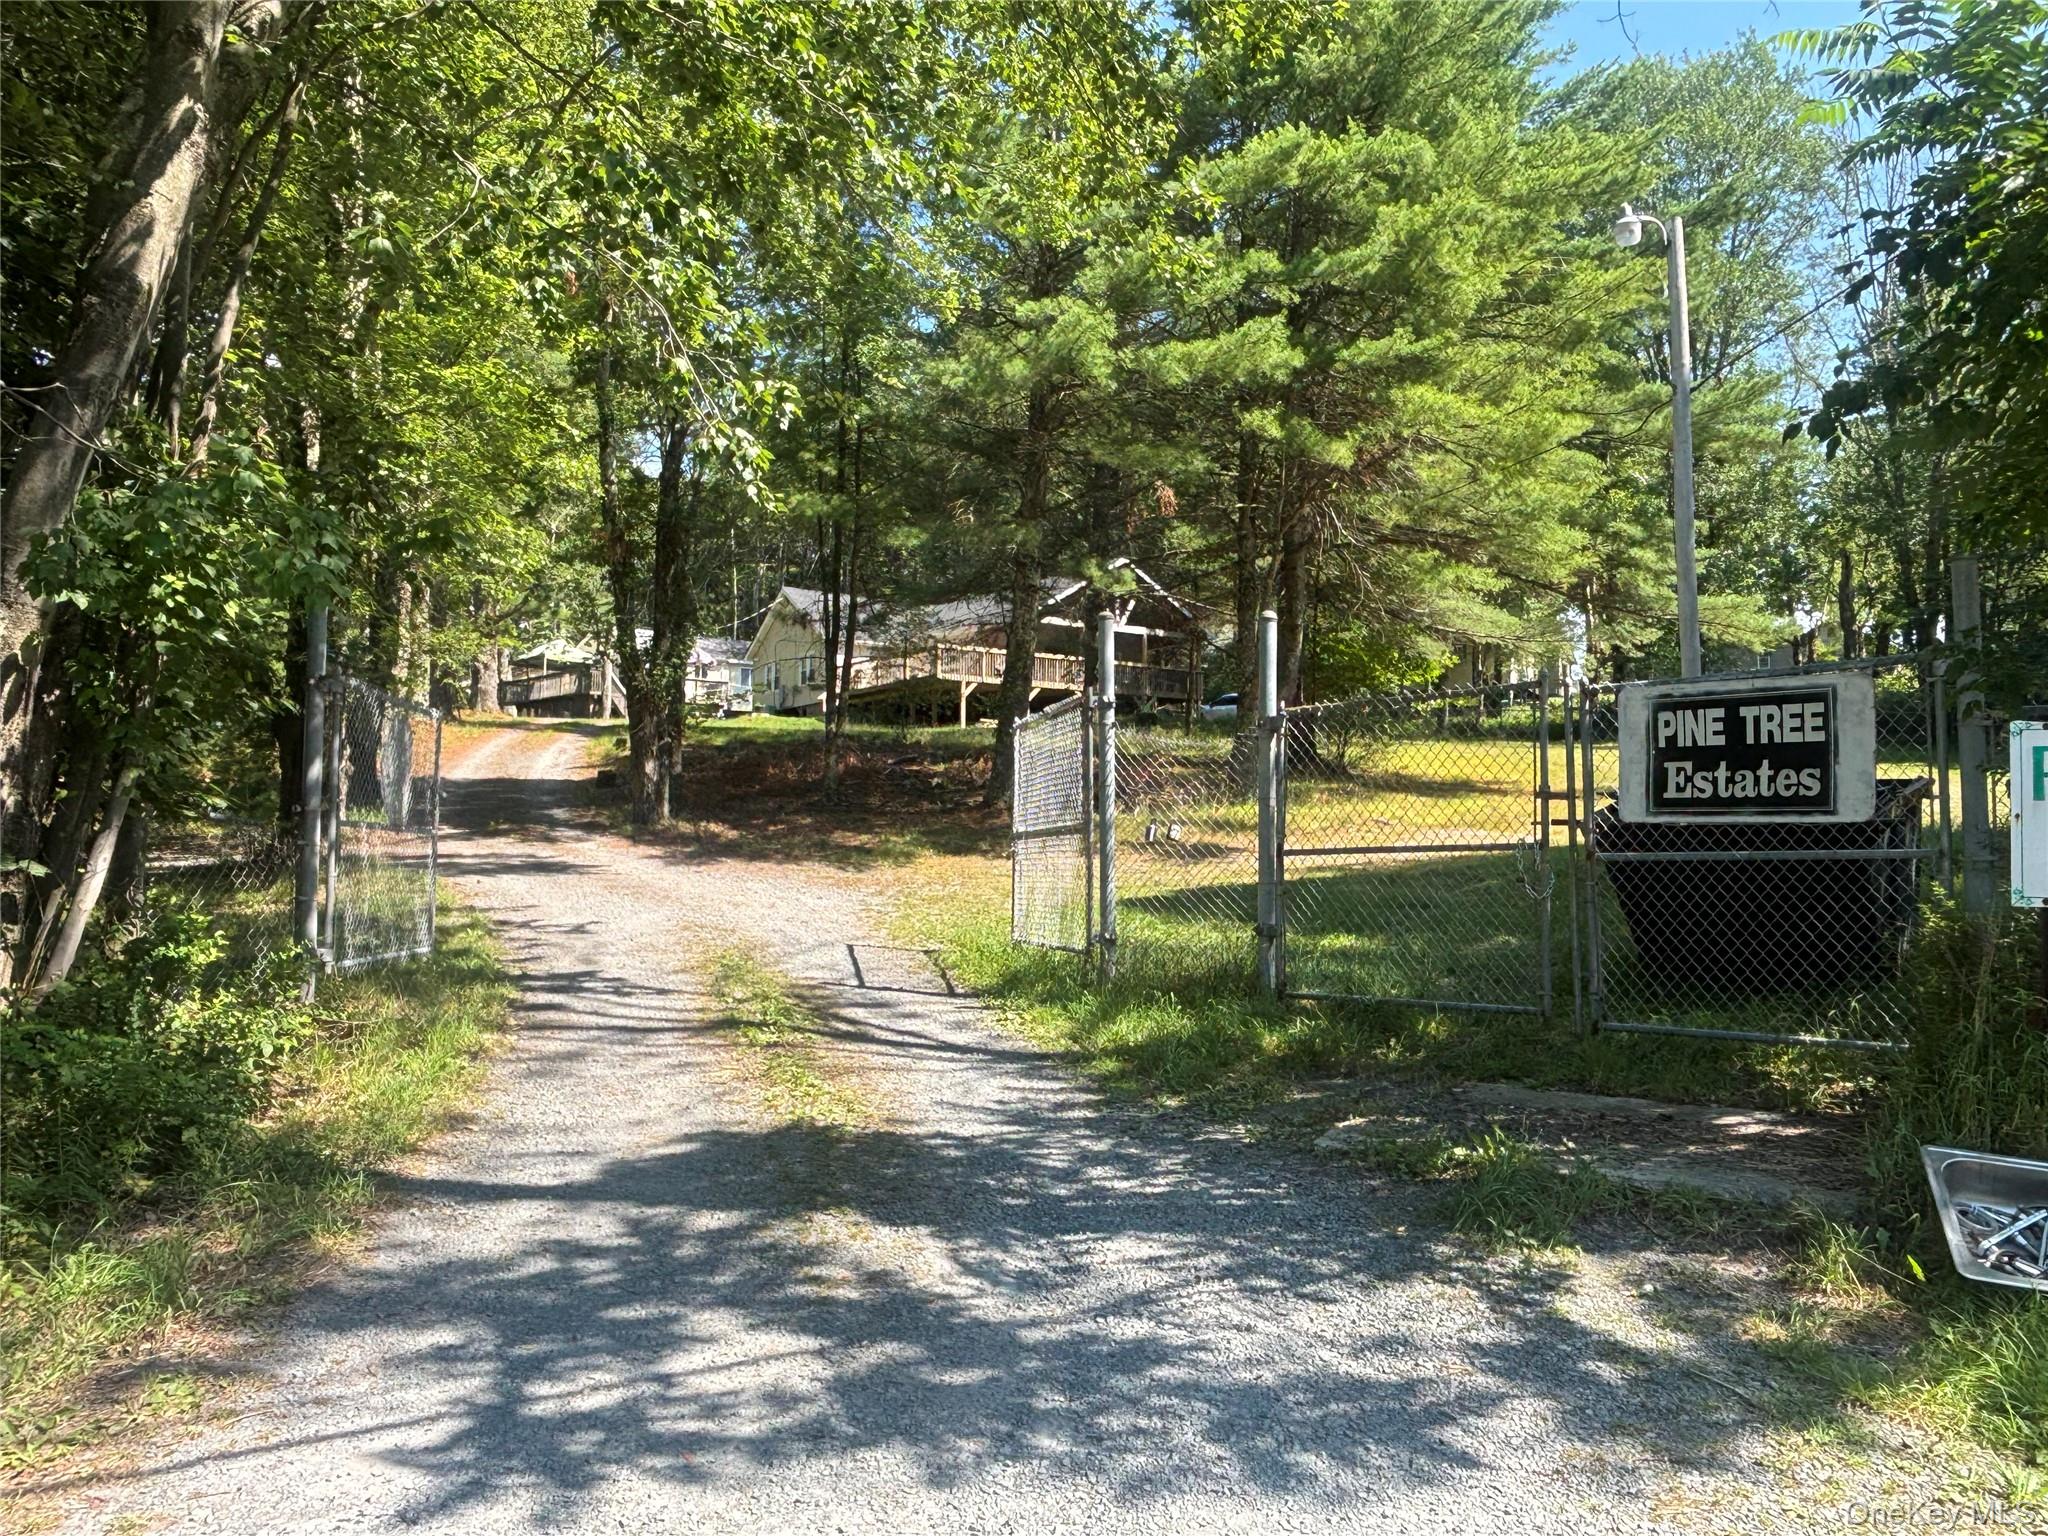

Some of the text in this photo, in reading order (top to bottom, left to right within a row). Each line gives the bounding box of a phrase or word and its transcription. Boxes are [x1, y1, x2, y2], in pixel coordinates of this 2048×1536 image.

[1658, 702, 1825, 747] PINE TREE
[1664, 759, 1821, 798] Estates
